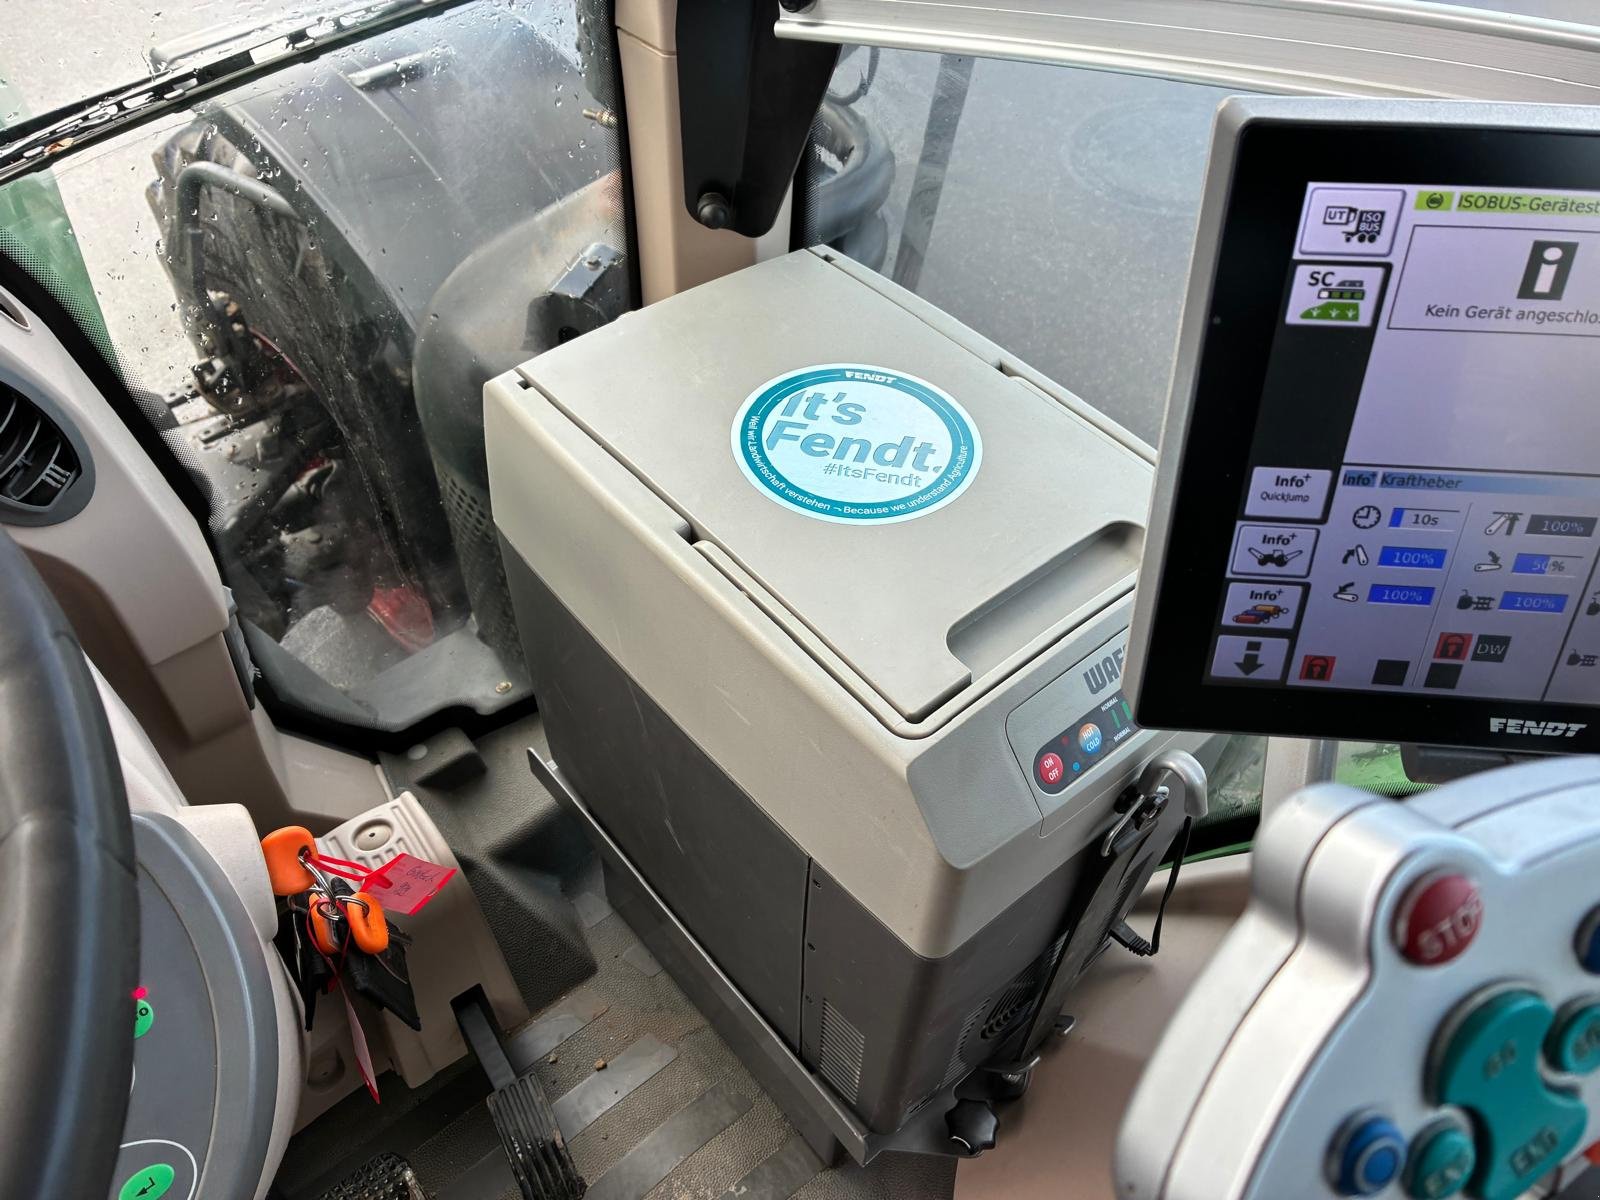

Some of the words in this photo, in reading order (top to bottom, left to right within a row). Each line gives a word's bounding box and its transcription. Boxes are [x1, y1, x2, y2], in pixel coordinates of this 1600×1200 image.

[1328, 210, 1346, 220] UT
[1362, 212, 1382, 222] ISO
[1359, 222, 1380, 231] BUS
[1308, 271, 1335, 287] SC
[1425, 304, 1460, 318] Kein
[1464, 304, 1512, 321] Gerät
[1517, 308, 1600, 325] angeschlo
[845, 371, 897, 384] FENDT
[781, 390, 867, 426] It's
[748, 415, 760, 430] Weil
[747, 430, 757, 441] wir
[766, 420, 942, 473] Fendt.
[748, 441, 786, 490] Landwirtschaft
[823, 462, 922, 488] #ItsFendt
[843, 505, 889, 515] Because
[890, 503, 907, 512] we
[908, 478, 952, 509] understand
[949, 445, 968, 482] Agriculture
[1381, 473, 1463, 489] Kraftheber
[785, 487, 831, 511] verstehen
[1413, 513, 1440, 526] 10s
[1542, 520, 1585, 534] 100%
[1393, 551, 1435, 566] 100%
[1531, 560, 1566, 572] 50%
[1382, 589, 1423, 602] 100%
[1514, 596, 1556, 609] 100%
[1476, 643, 1506, 655] DW
[1101, 697, 1119, 712] NORMAL
[1082, 727, 1095, 741] HOT
[1113, 726, 1132, 742] NORMAL
[1490, 717, 1588, 738] FENDT
[1086, 736, 1101, 752] COLD
[1044, 758, 1054, 769] ON
[1048, 769, 1060, 781] OFF
